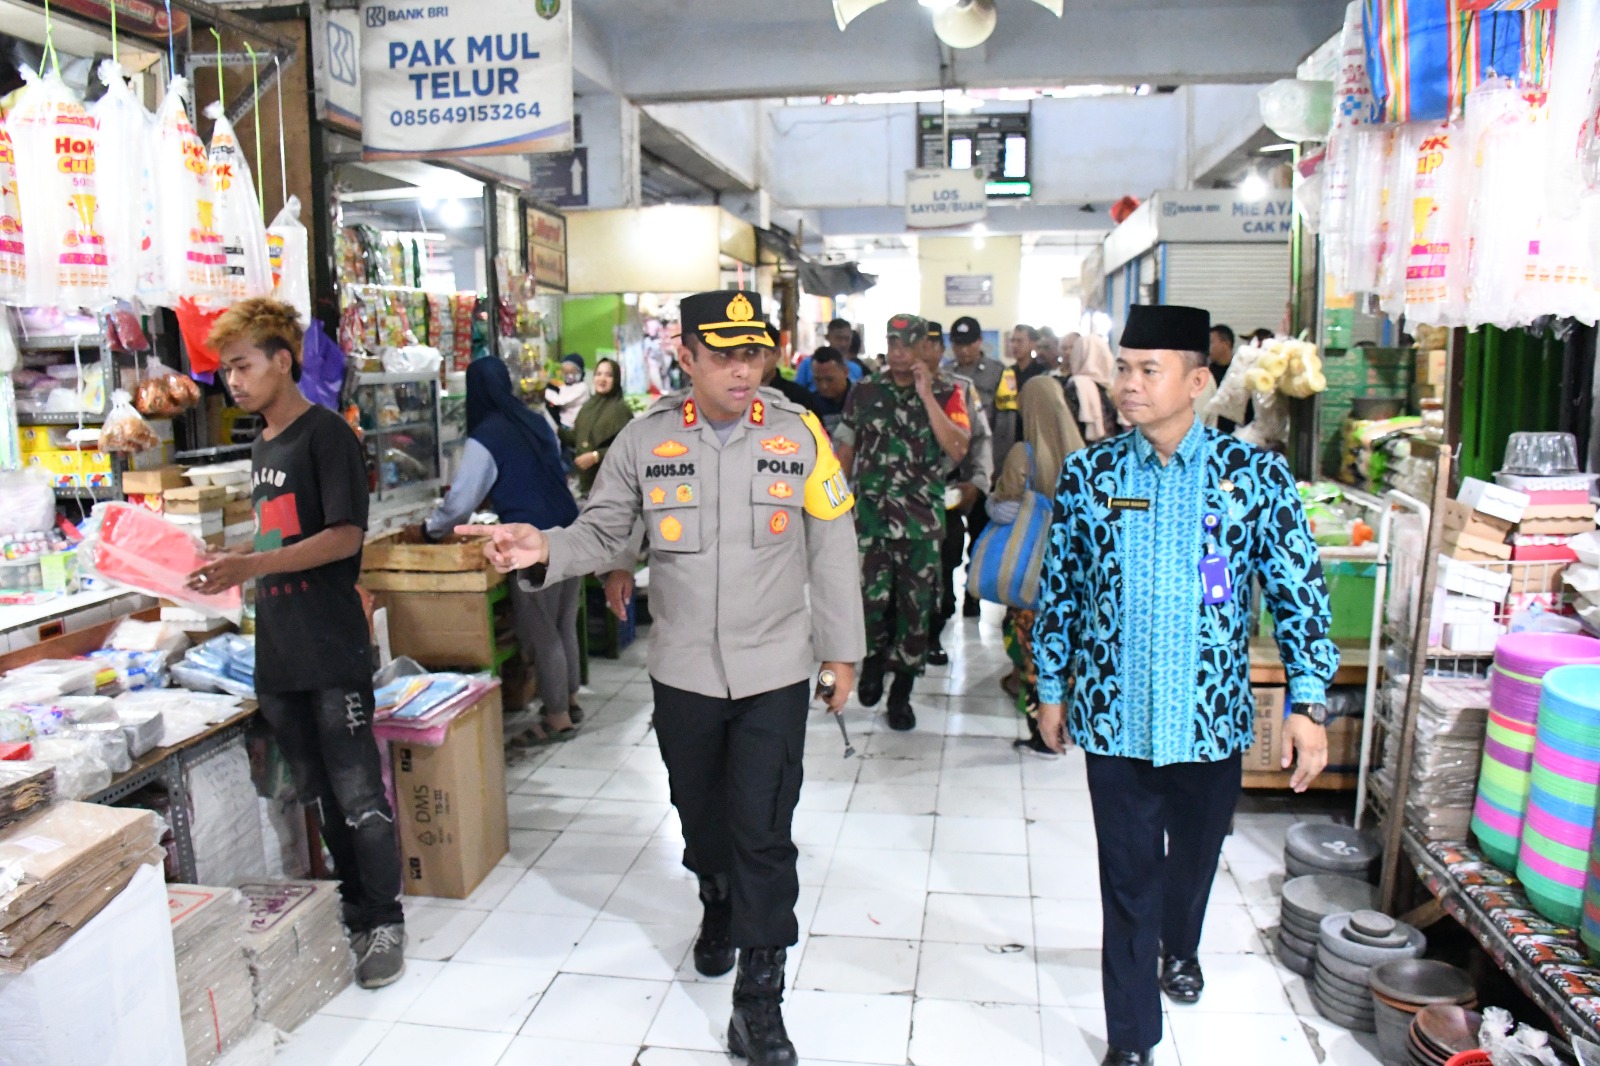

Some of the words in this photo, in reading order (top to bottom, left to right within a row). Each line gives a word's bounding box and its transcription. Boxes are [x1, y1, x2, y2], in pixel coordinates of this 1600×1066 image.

[388, 8, 424, 21] BANK
[428, 6, 448, 18] BRI
[389, 37, 456, 69] PAK
[467, 32, 540, 63] MUL
[408, 67, 519, 100] TELUR
[390, 102, 541, 127] 085649153264
[933, 189, 958, 200] LOS
[911, 202, 984, 214] SAYUR/BUAH
[1243, 221, 1275, 233] CAK
[645, 463, 696, 478] AGUS.DS
[757, 458, 804, 476] POLRI
[413, 785, 431, 823] DMS
